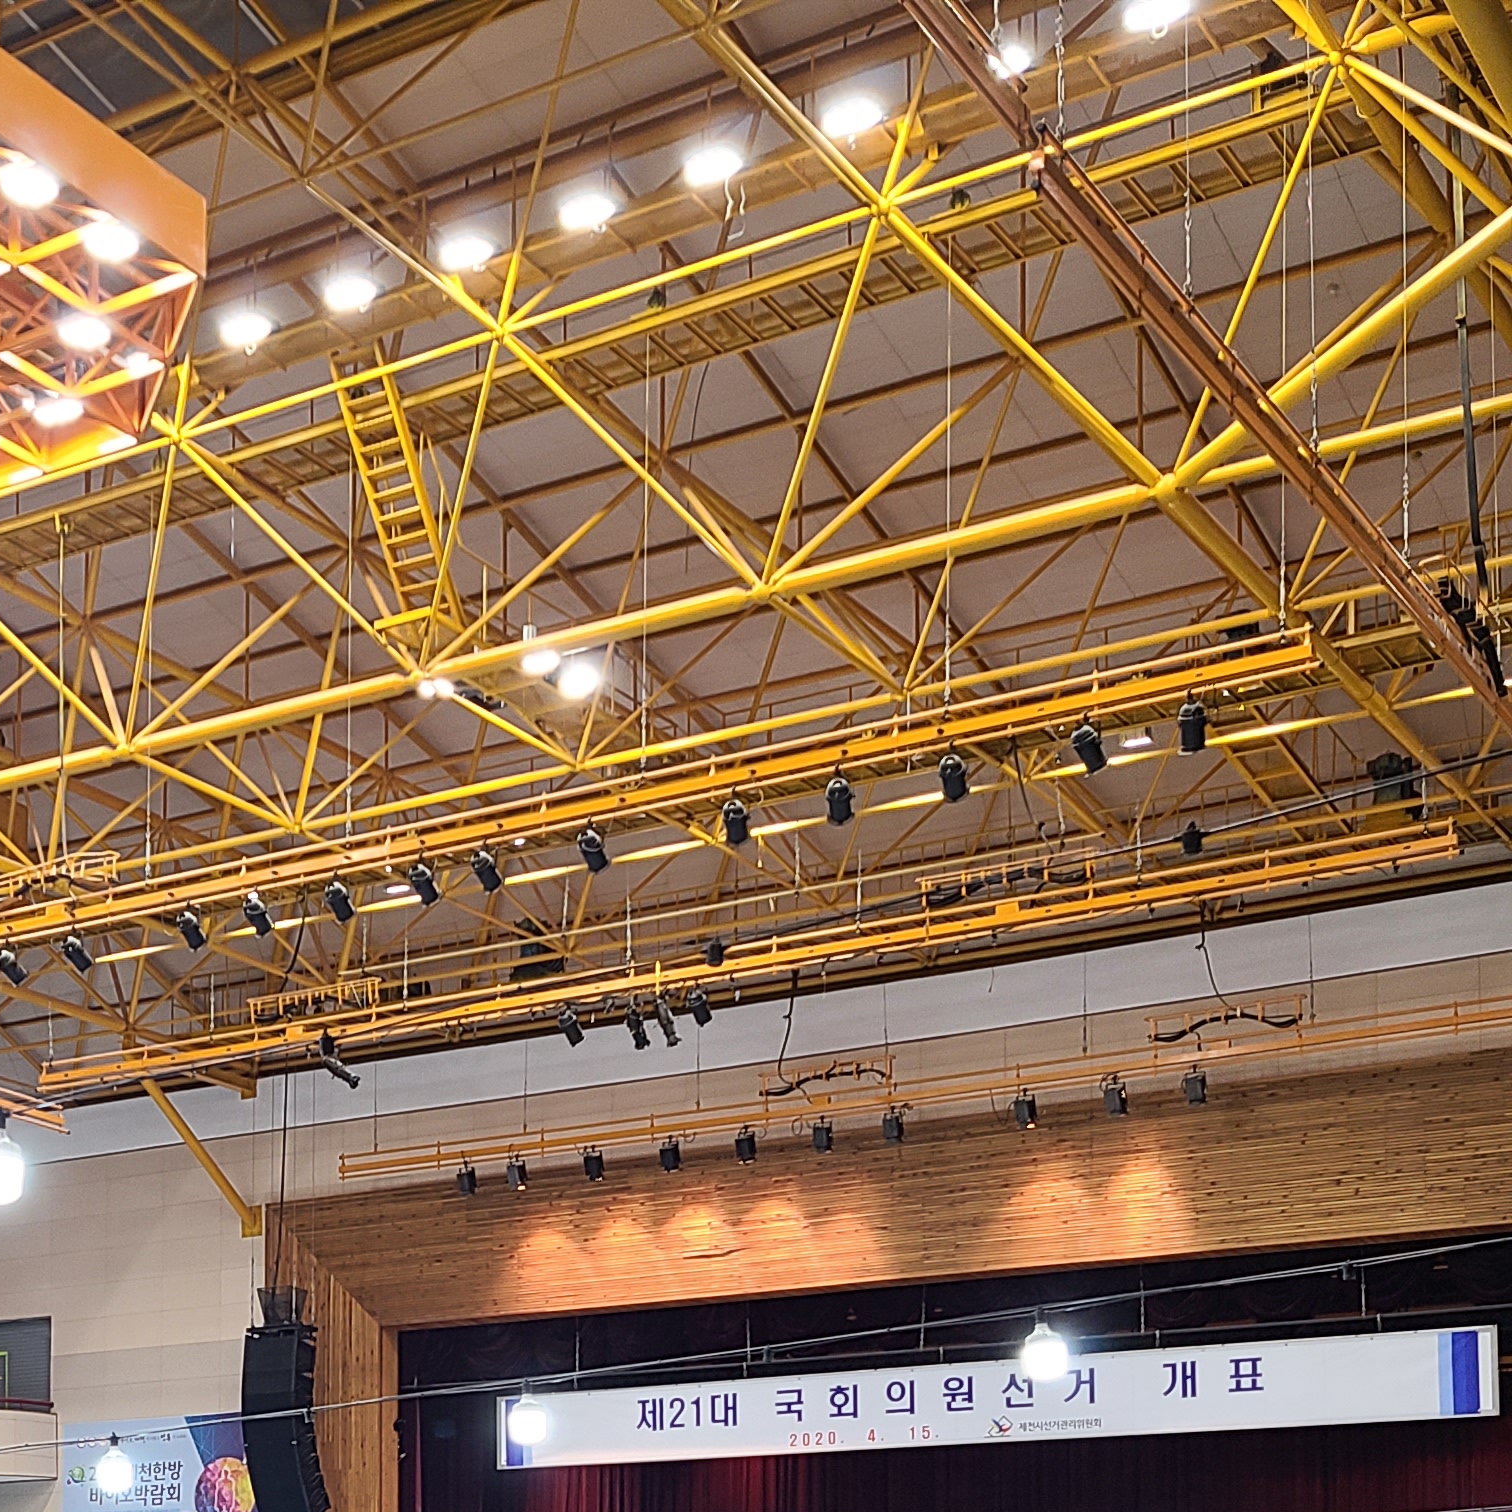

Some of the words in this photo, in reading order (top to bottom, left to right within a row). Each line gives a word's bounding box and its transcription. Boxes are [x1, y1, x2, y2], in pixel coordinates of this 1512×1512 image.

[636, 1391, 739, 1432] 제21대
[1162, 1356, 1265, 1399] 개표
[1017, 1417, 1103, 1433] 제천시선거관리위원회
[789, 1431, 846, 1447] 2020.
